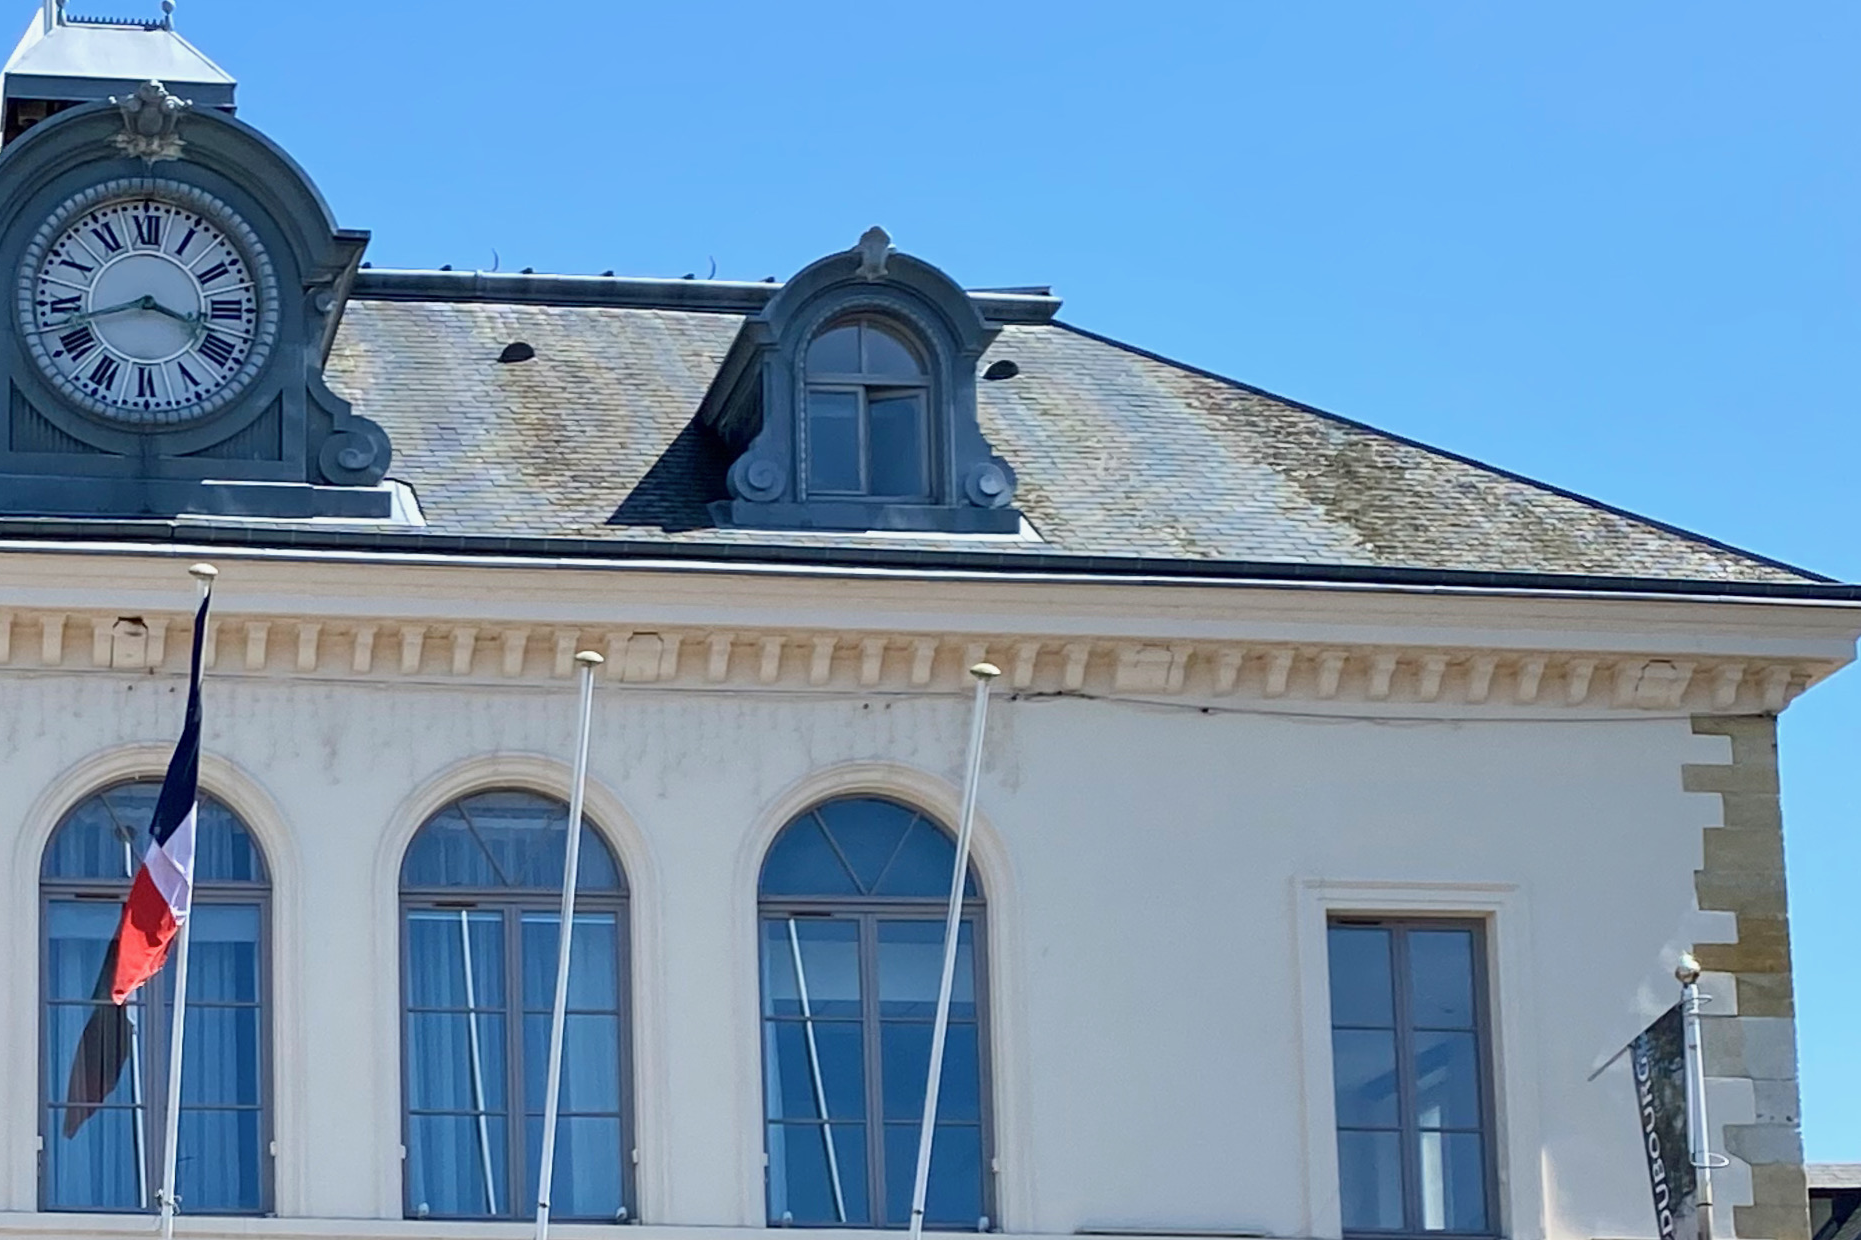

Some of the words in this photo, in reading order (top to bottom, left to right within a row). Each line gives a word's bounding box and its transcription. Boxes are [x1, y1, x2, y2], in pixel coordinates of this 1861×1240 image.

[90, 221, 124, 254] XI
[132, 215, 162, 246] XII
[175, 227, 197, 257] I
[58, 249, 94, 280] X
[197, 262, 230, 286] II
[210, 299, 243, 321] III
[198, 332, 236, 368] IIII
[177, 361, 201, 391] V
[1635, 1056, 1674, 1236] DUBOURG
